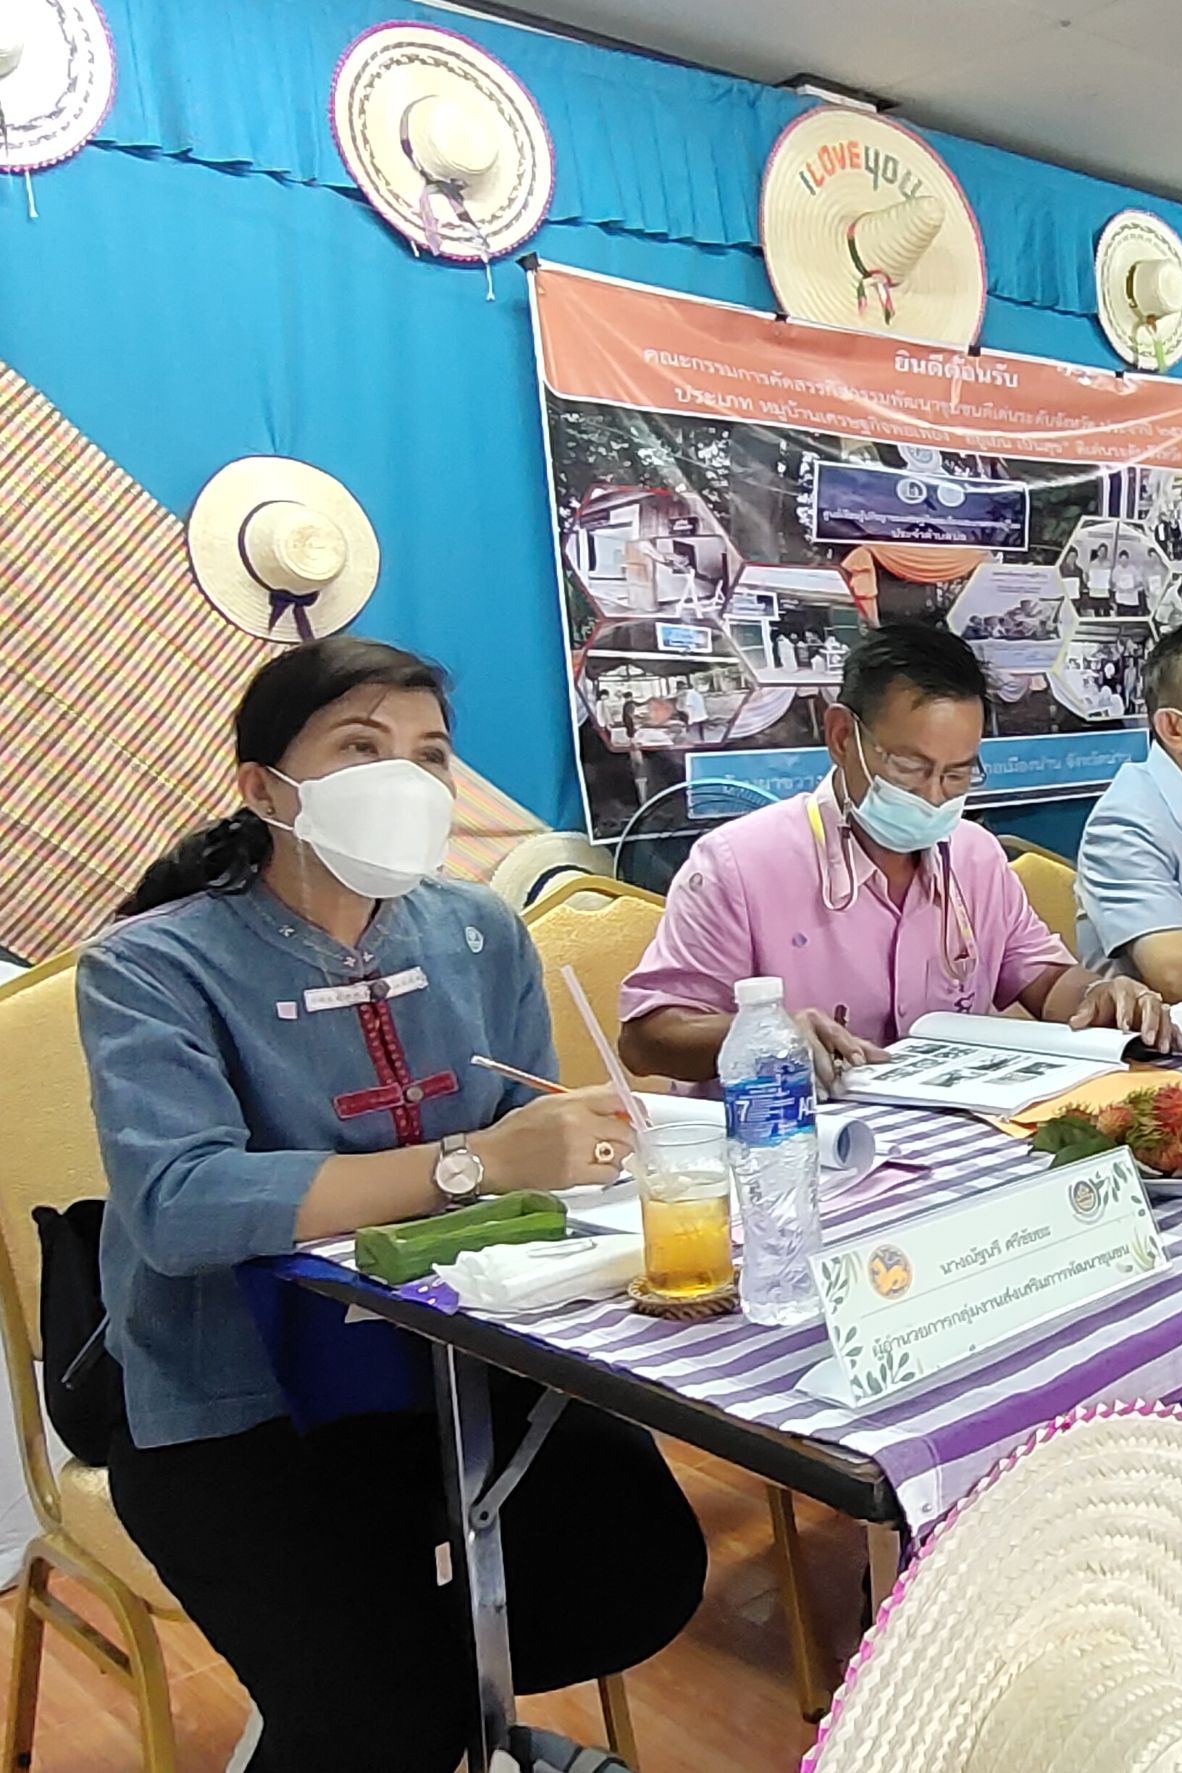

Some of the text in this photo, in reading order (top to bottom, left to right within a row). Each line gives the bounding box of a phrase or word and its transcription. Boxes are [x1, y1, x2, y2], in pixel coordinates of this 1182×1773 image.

[805, 140, 862, 188] LOVE
[895, 349, 1019, 388] ยินดีต้อนรับ
[674, 384, 754, 411] ประเภท
